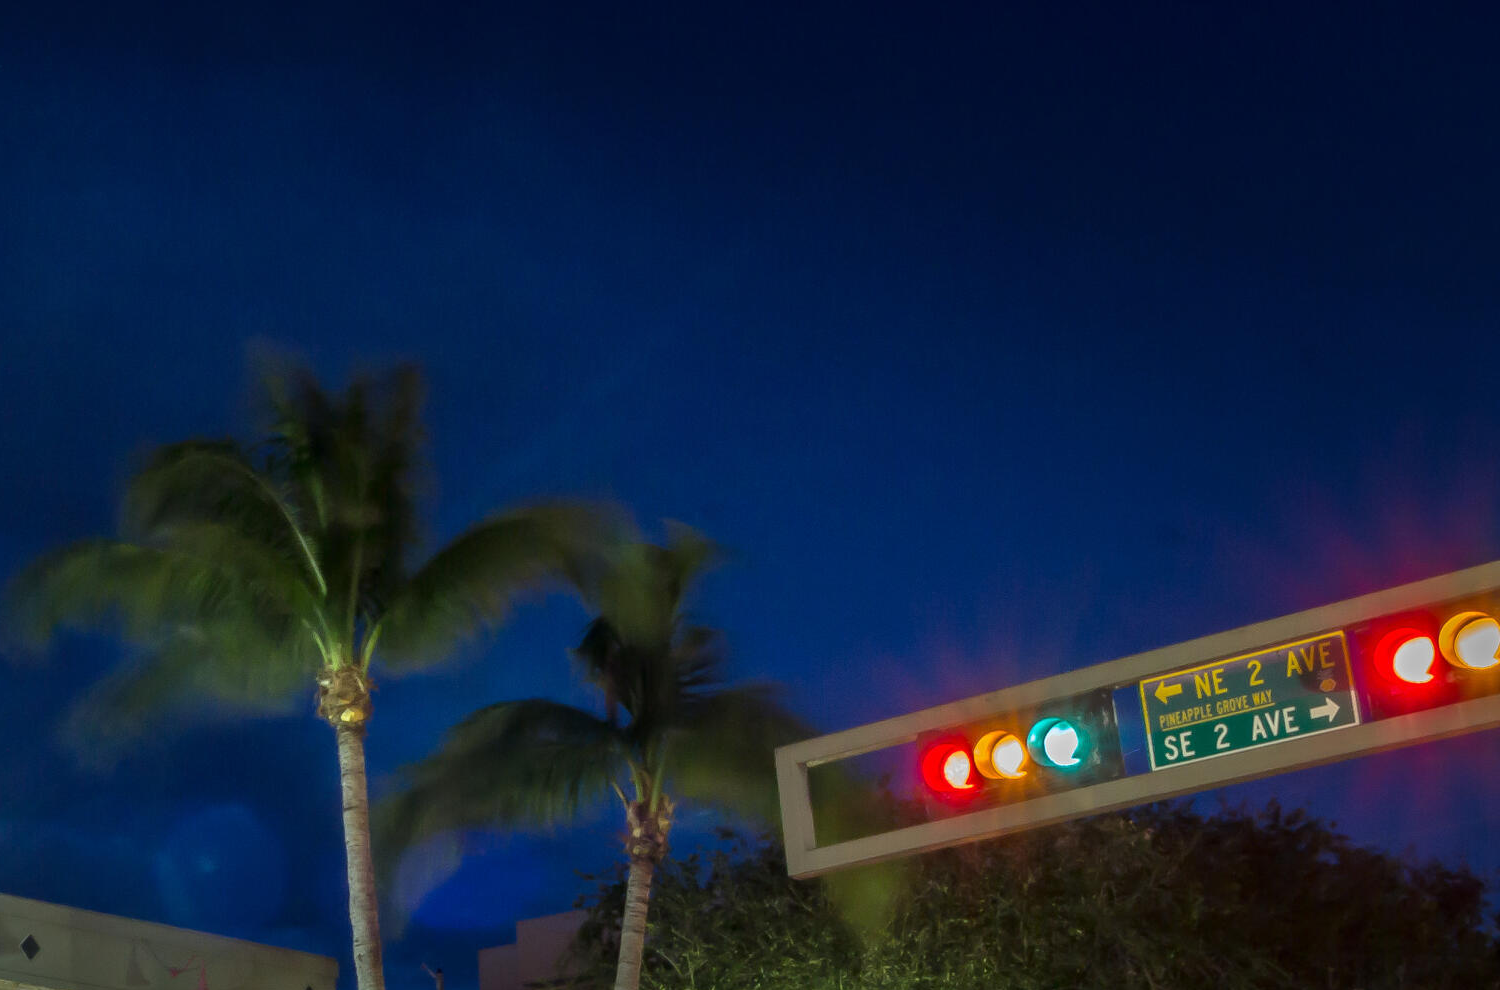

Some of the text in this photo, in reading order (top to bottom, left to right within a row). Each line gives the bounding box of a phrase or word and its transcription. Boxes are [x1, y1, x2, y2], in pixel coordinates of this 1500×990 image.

[1193, 641, 1336, 700] NE 2 AVE
[1158, 689, 1274, 728] PINEAPPLE GROVE WAY
[1163, 706, 1300, 761] SE 2 AVE
